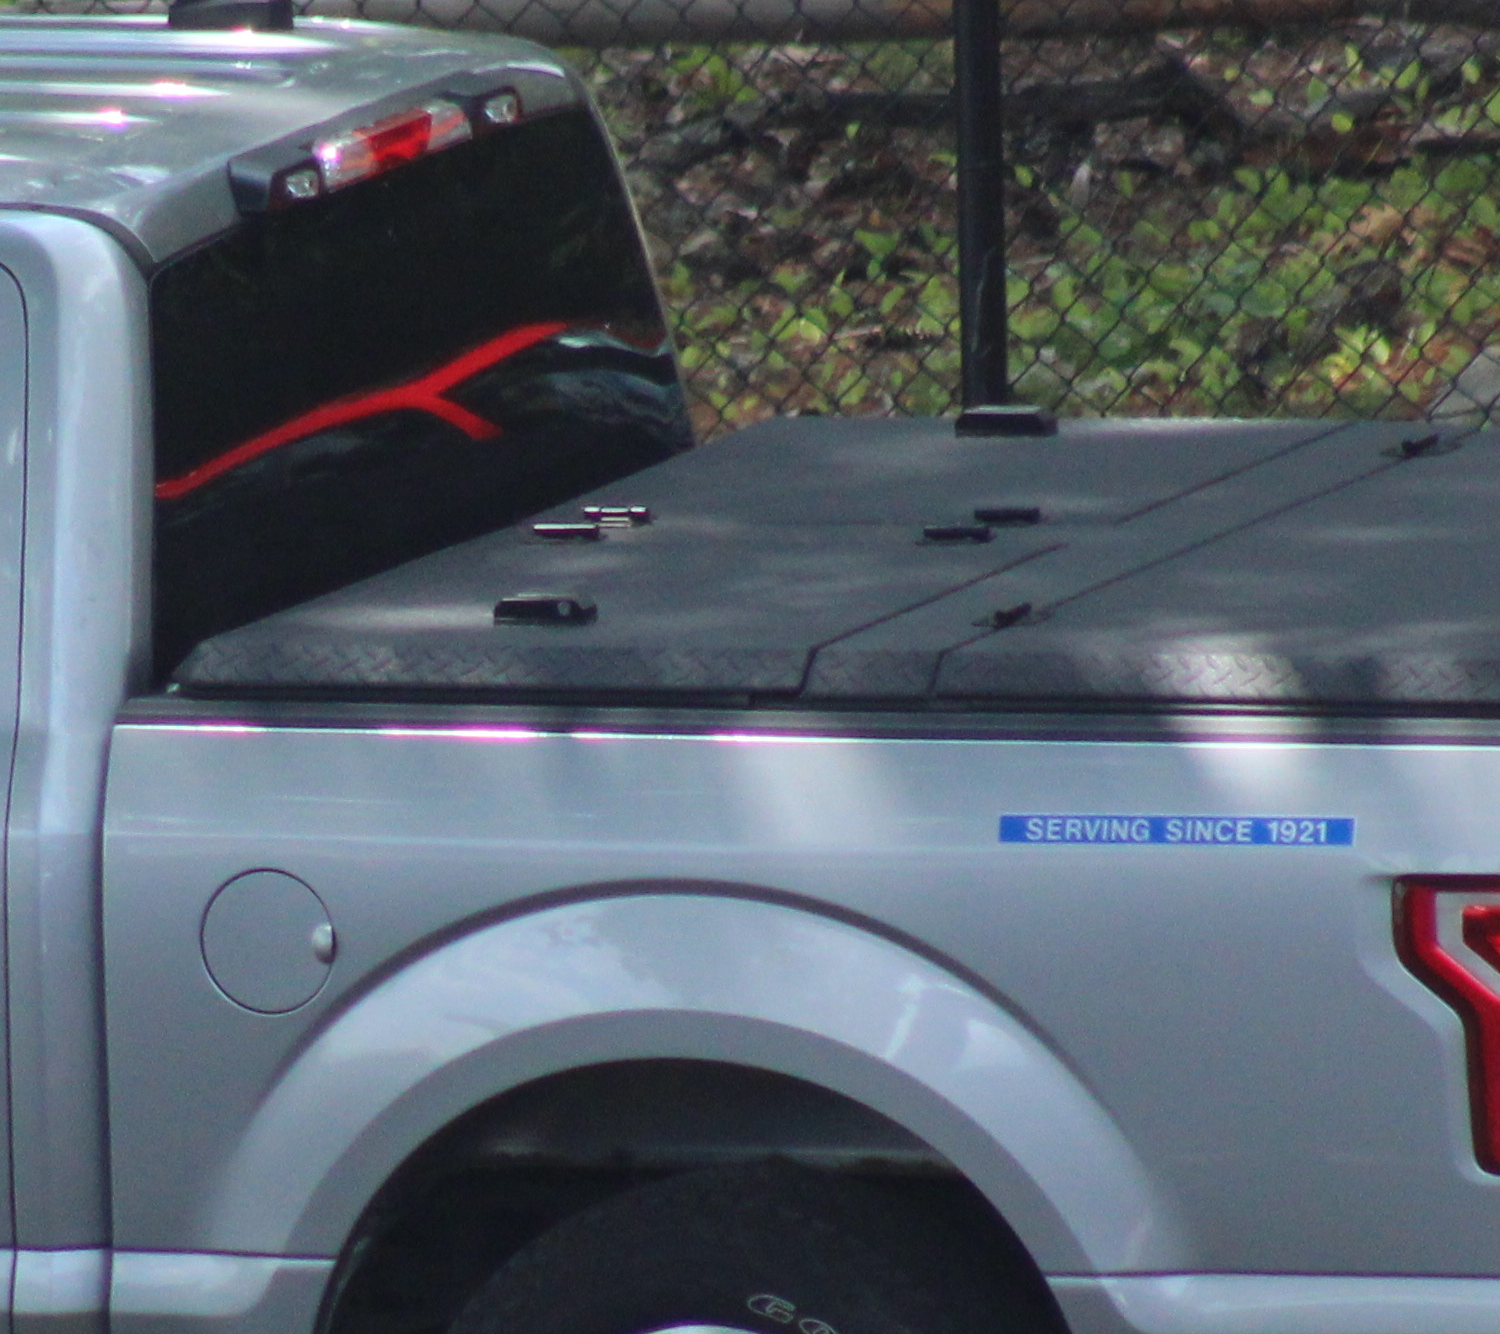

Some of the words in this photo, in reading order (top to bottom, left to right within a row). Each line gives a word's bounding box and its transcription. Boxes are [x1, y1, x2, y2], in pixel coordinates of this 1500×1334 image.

[1025, 818, 1150, 843] SERVING
[1165, 819, 1253, 844] SINCE
[1267, 821, 1328, 844] 1921
